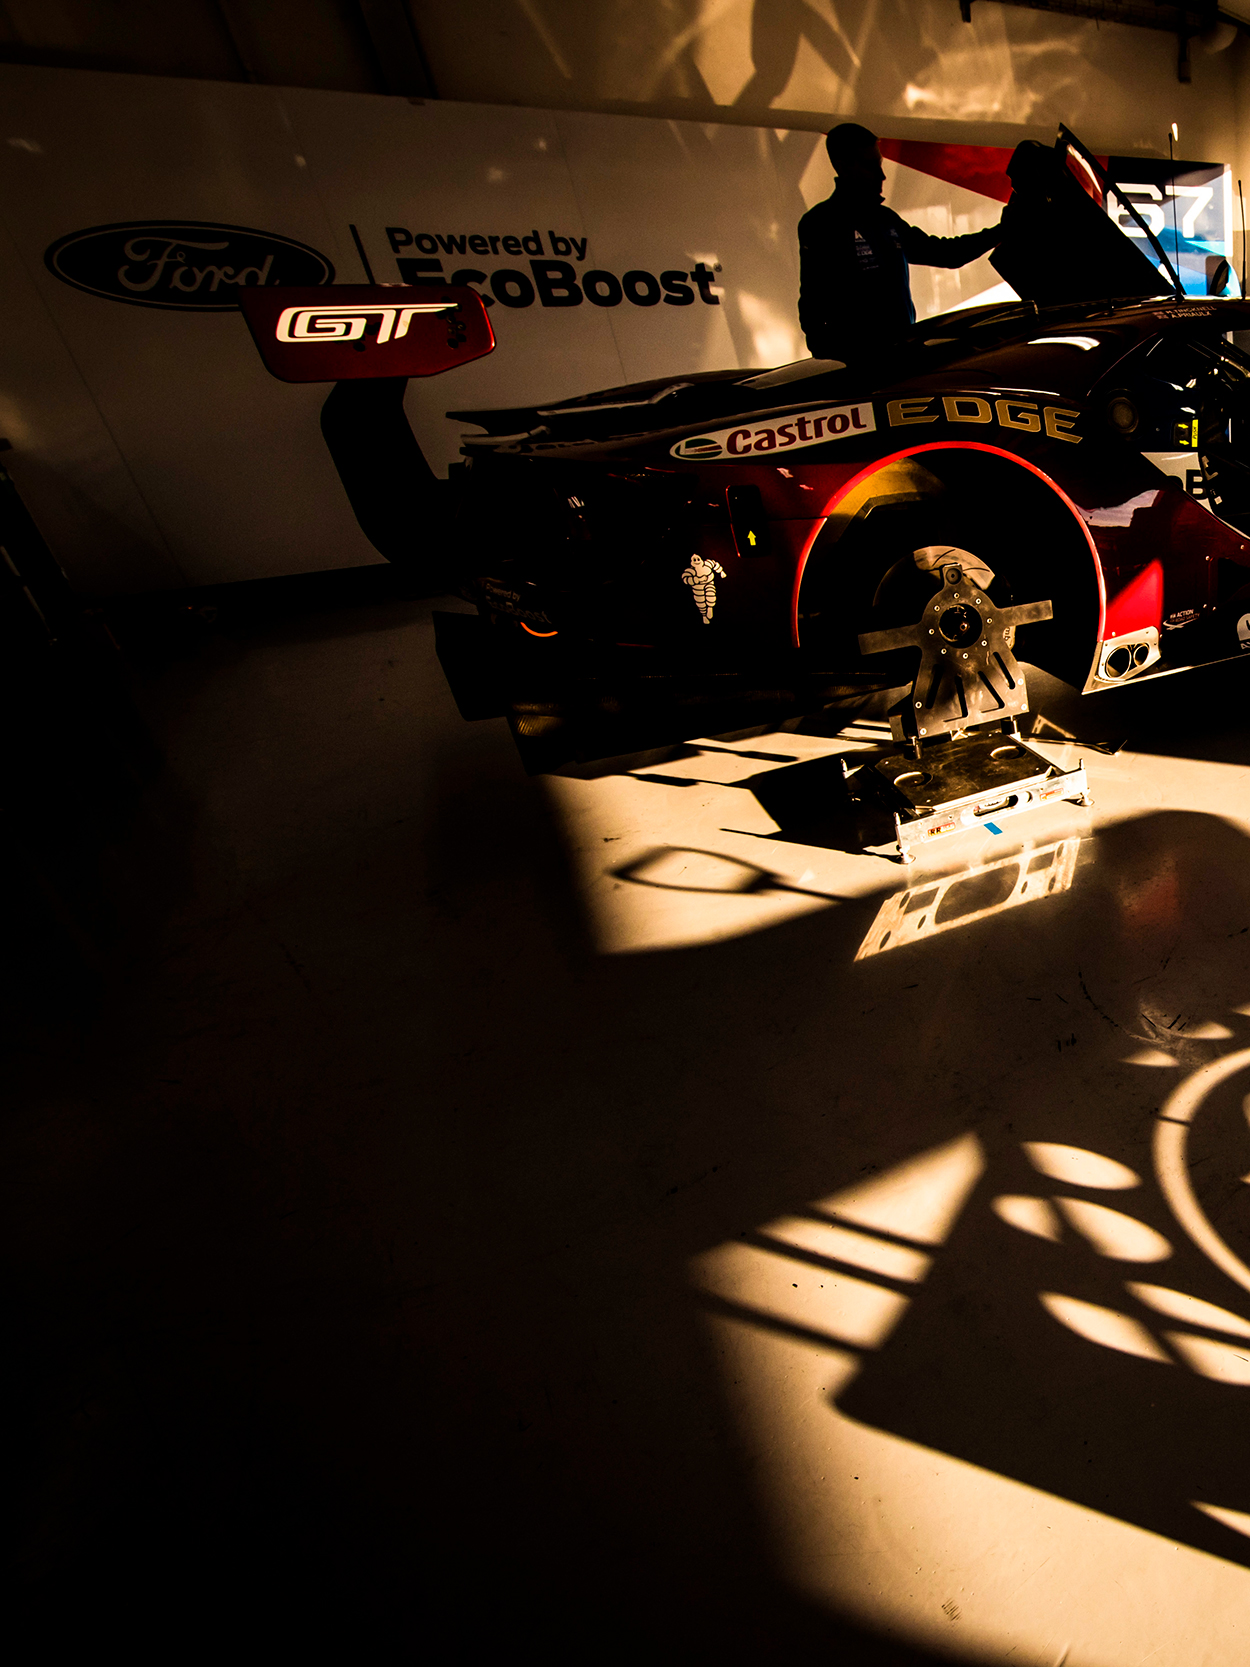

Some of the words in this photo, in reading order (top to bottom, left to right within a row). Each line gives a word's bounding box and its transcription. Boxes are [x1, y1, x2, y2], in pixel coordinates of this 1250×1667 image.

[116, 236, 280, 292] Ford
[385, 227, 542, 256] Powered
[547, 231, 588, 260] by
[276, 303, 459, 344] GT
[726, 408, 866, 455] Castrol
[886, 396, 1083, 444] EDGE
